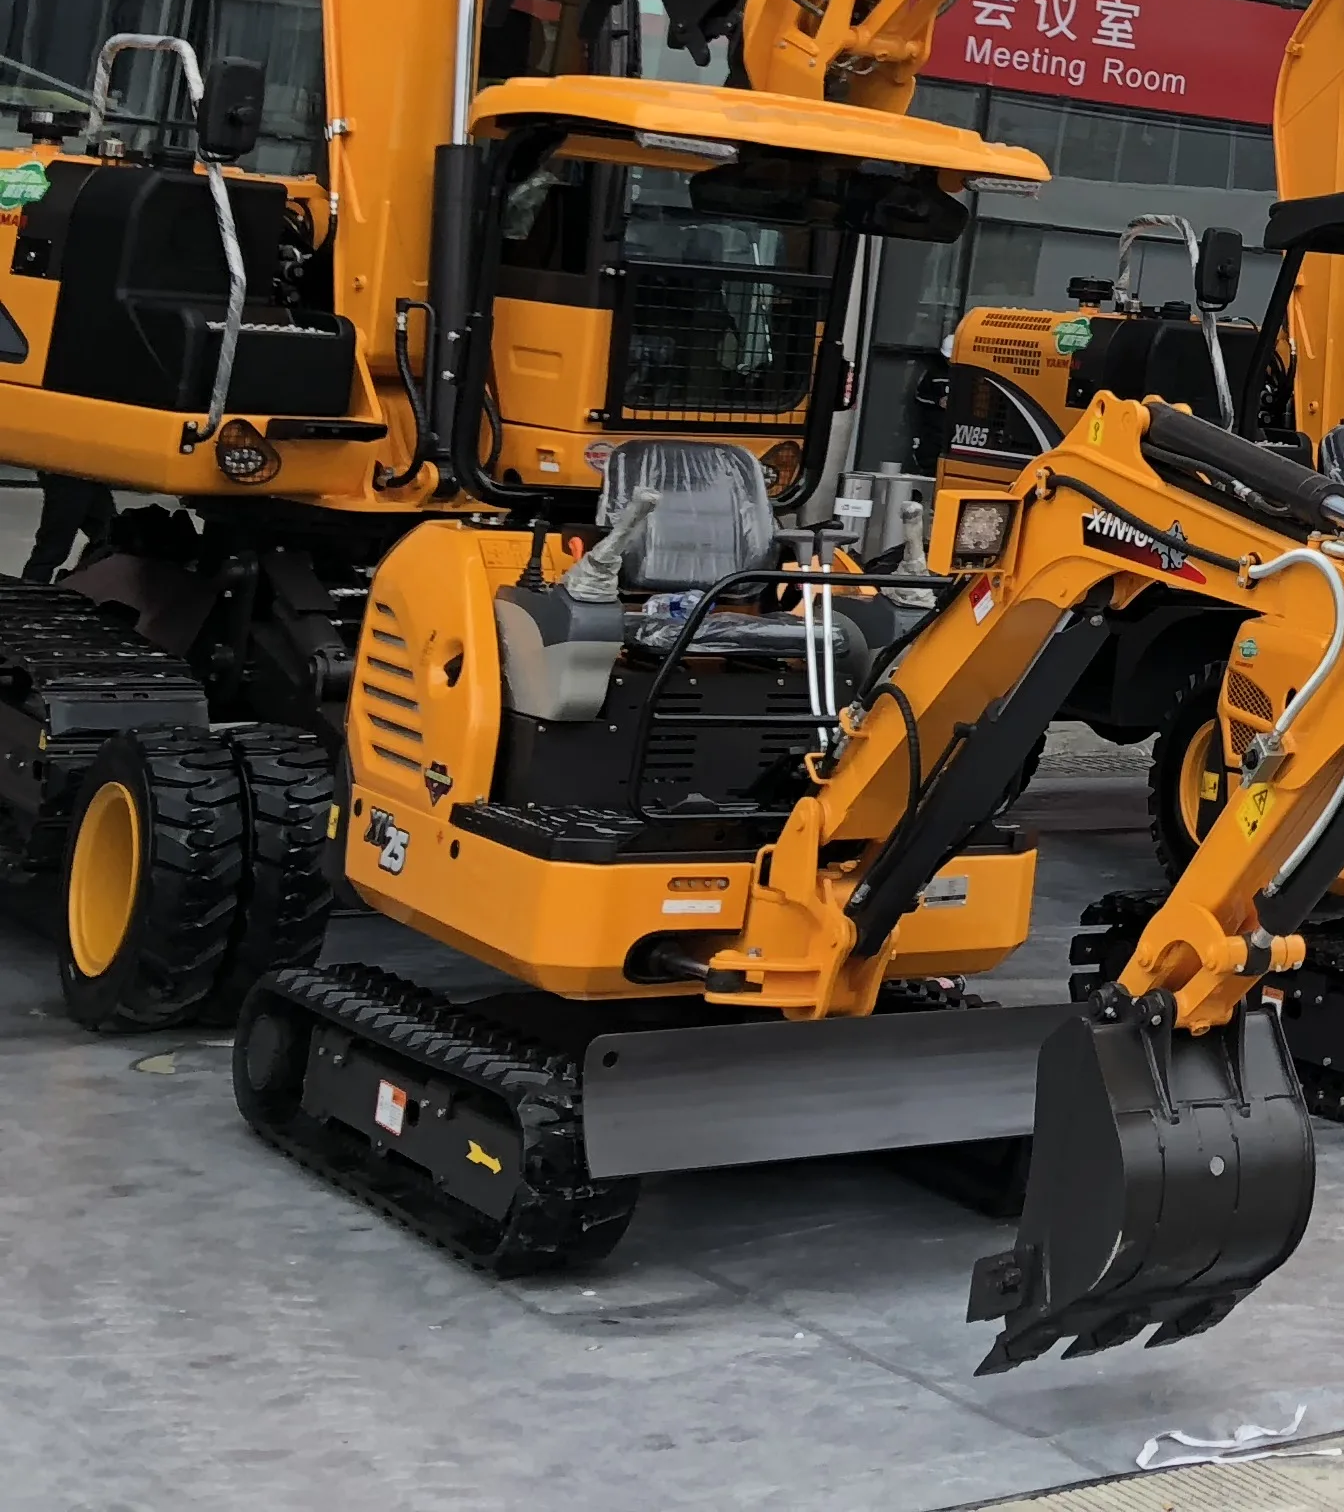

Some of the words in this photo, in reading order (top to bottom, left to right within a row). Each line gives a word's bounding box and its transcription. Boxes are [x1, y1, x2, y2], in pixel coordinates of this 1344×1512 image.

[964, 36, 1086, 86] Meeting
[1102, 58, 1186, 95] Room
[951, 423, 989, 446] XN85
